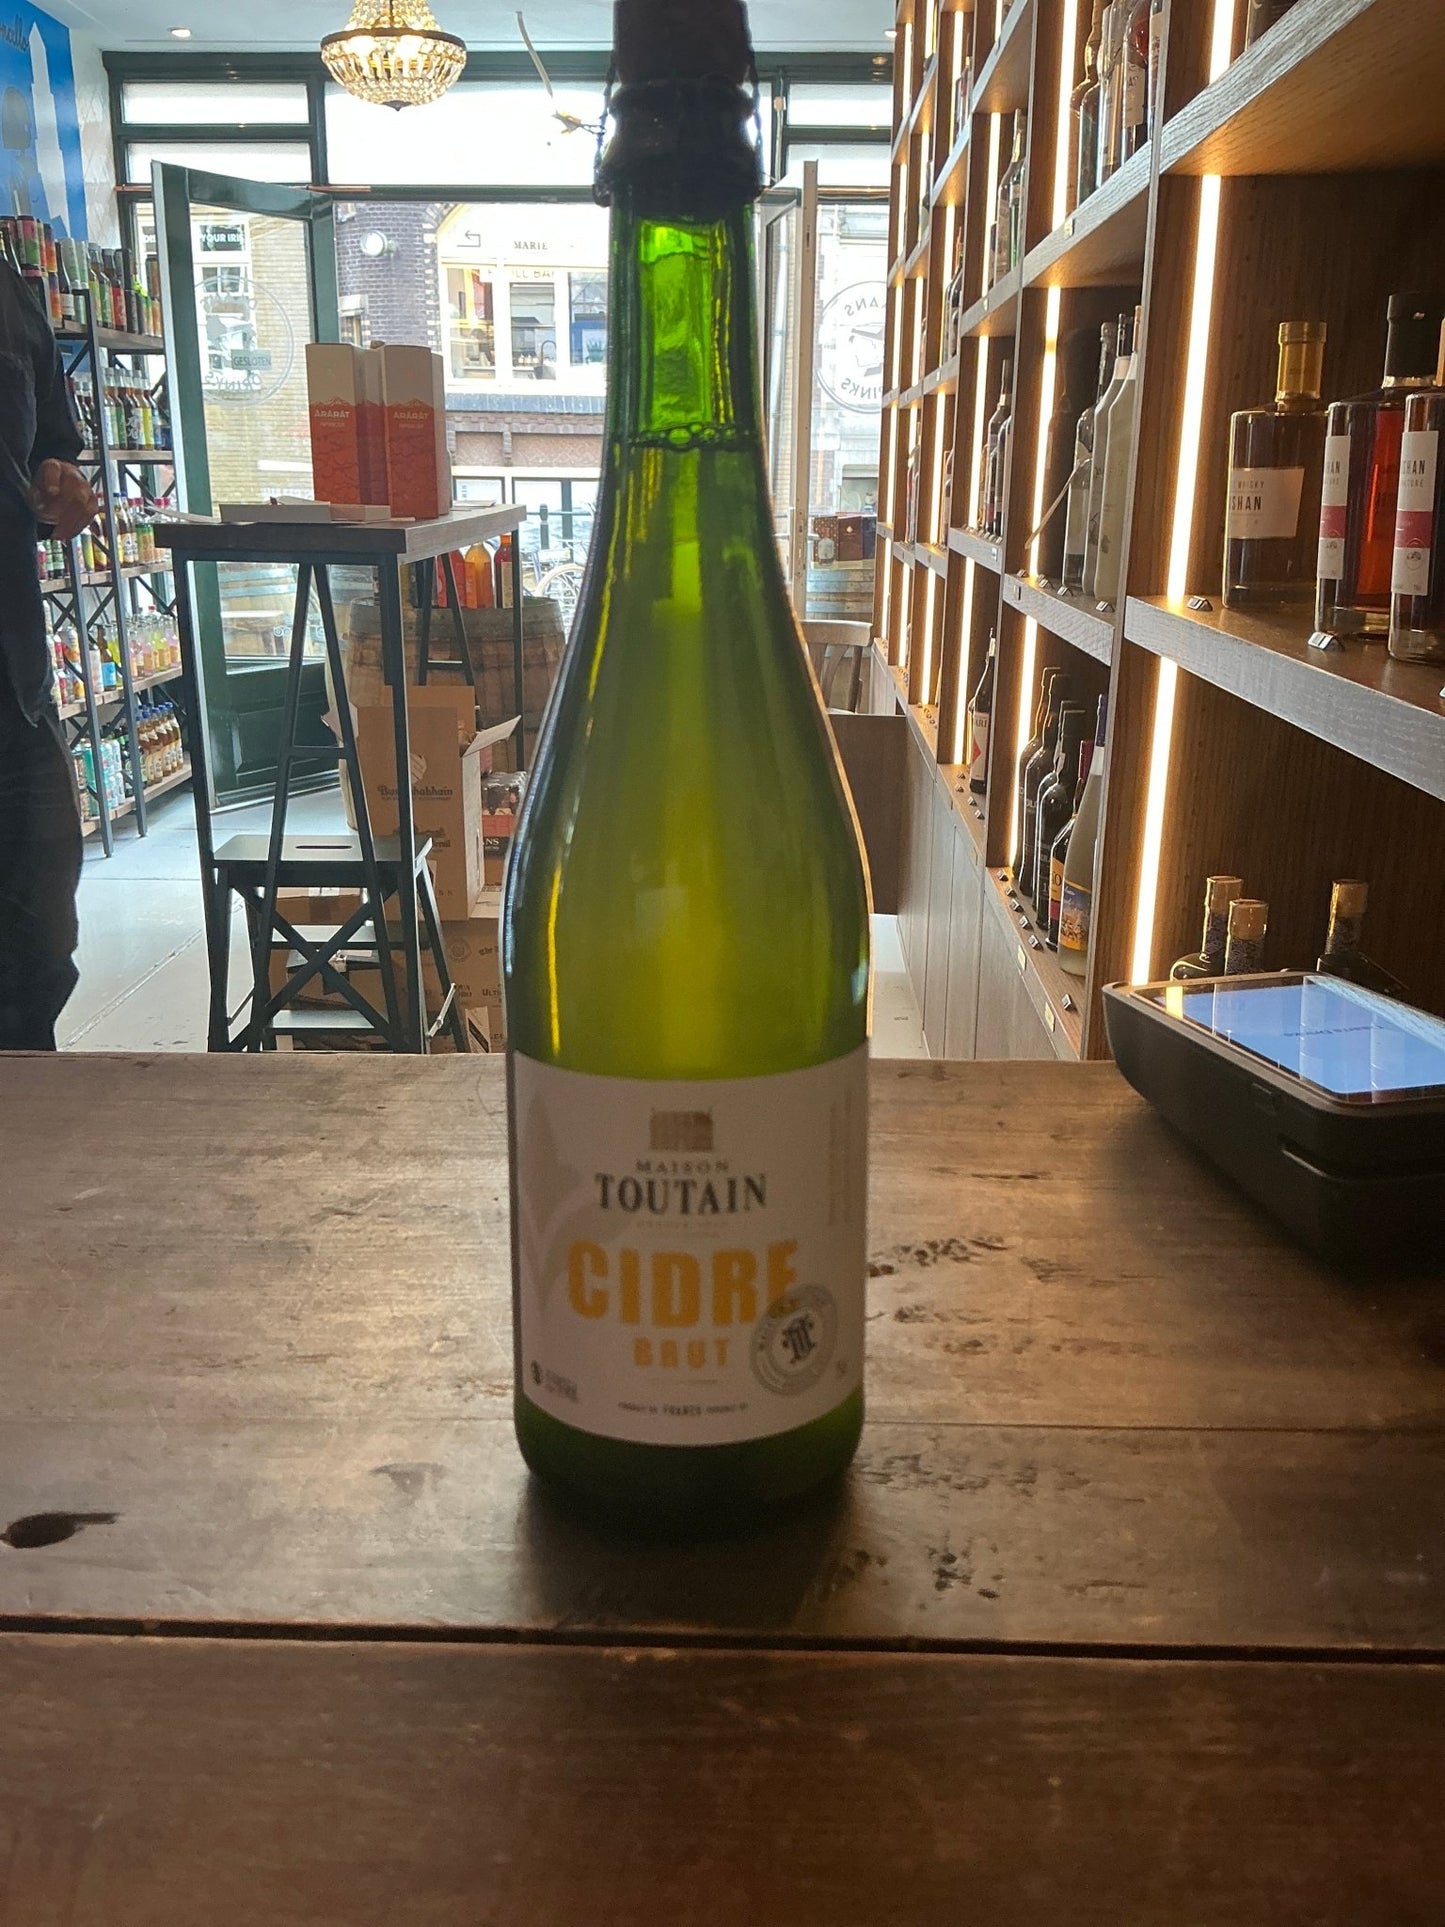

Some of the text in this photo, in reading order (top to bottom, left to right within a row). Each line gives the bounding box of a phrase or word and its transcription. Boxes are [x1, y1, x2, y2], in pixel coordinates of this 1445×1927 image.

[201, 233, 226, 243] YOUR
[514, 241, 548, 250] MARIE
[314, 410, 350, 418] ARARAT
[393, 411, 429, 420] ARARAT
[635, 1160, 730, 1174] MAISON
[594, 1173, 767, 1215] TOUTAIN
[567, 1237, 798, 1328] CIDRE
[634, 1337, 729, 1368] BRUT
